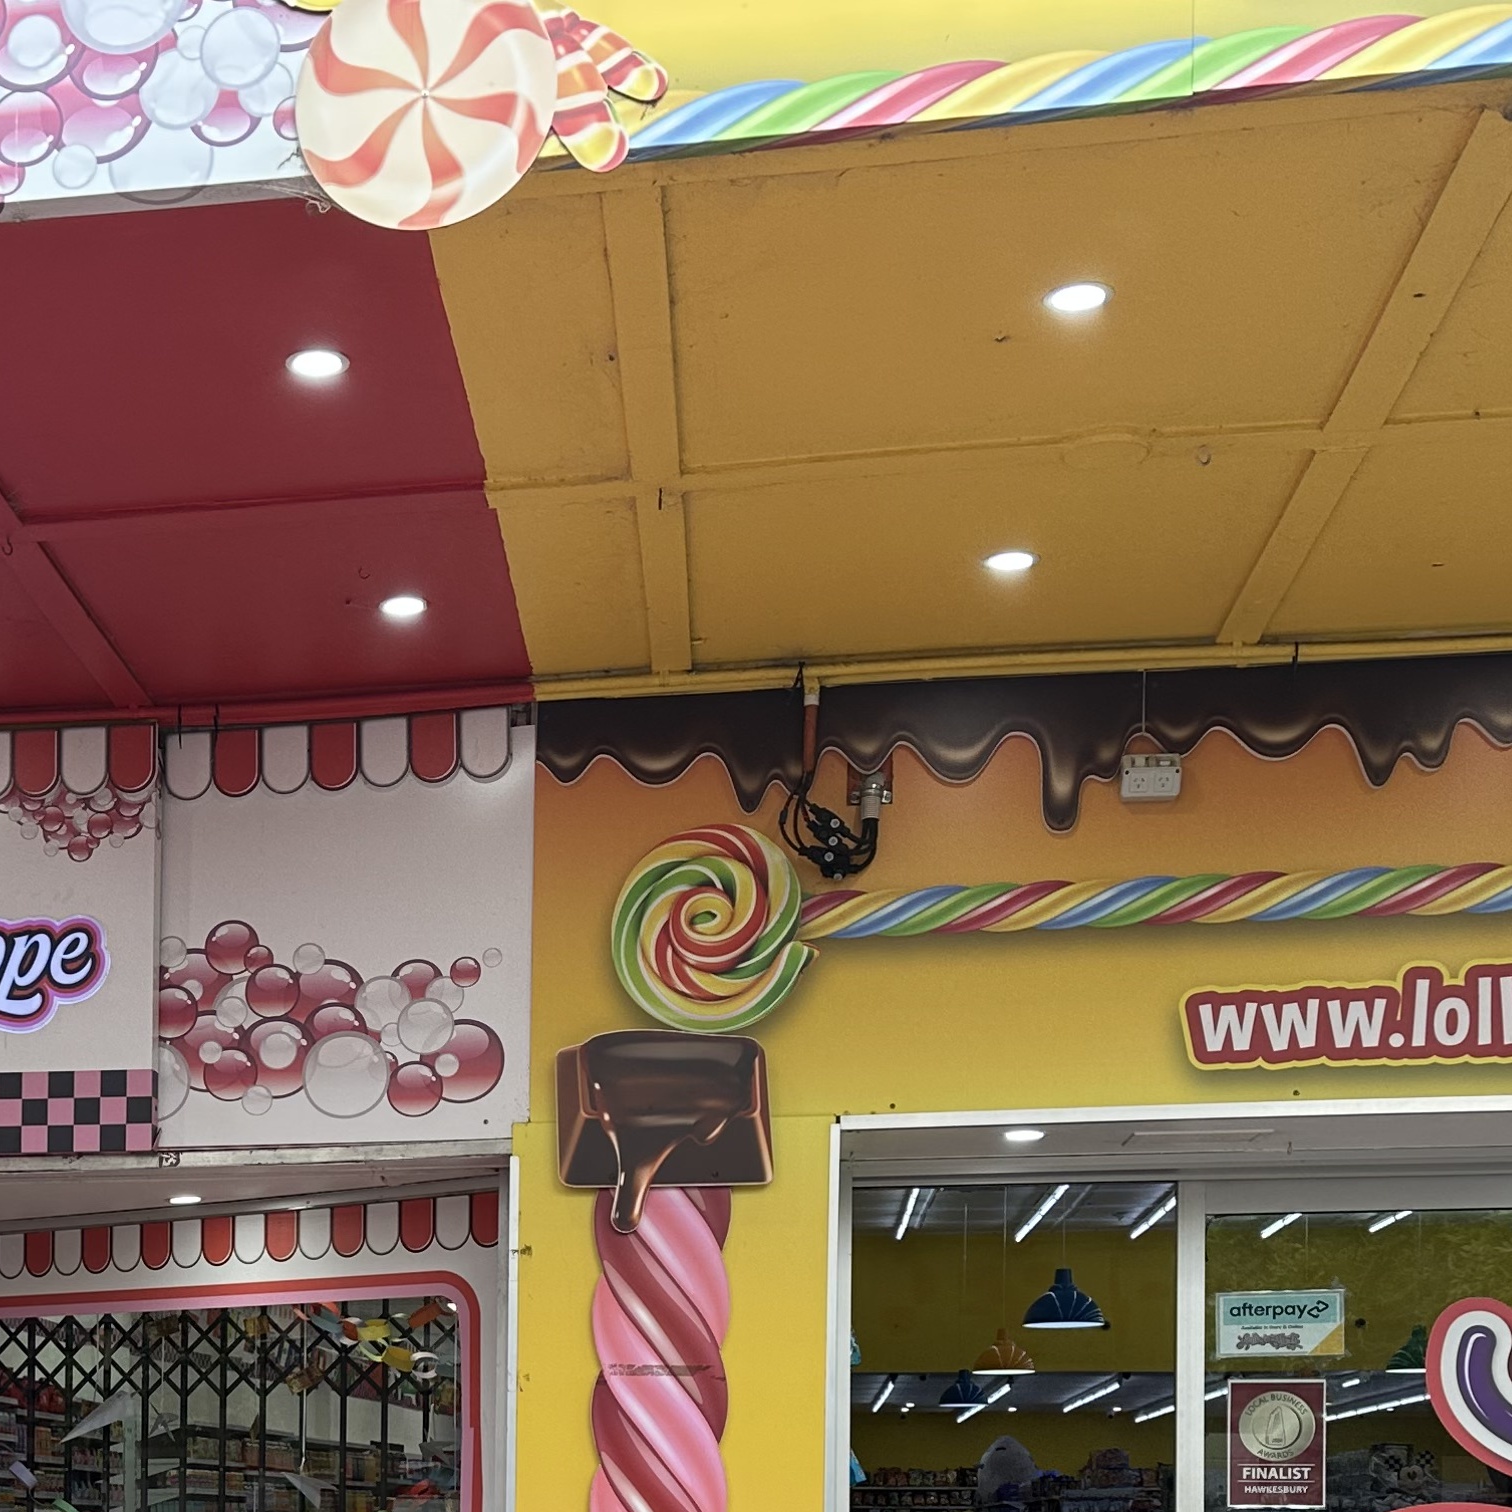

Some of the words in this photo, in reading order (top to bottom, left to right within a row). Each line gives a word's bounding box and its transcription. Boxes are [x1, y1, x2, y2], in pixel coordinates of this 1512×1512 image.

[1229, 1302, 1308, 1320] afterpay
[1244, 1396, 1270, 1416] LOCAL
[1270, 1393, 1308, 1416] BUSINESS
[1257, 1448, 1295, 1460] AWARDS
[1242, 1467, 1312, 1480] FINALIST
[1244, 1485, 1309, 1495] HAWKESBURY
